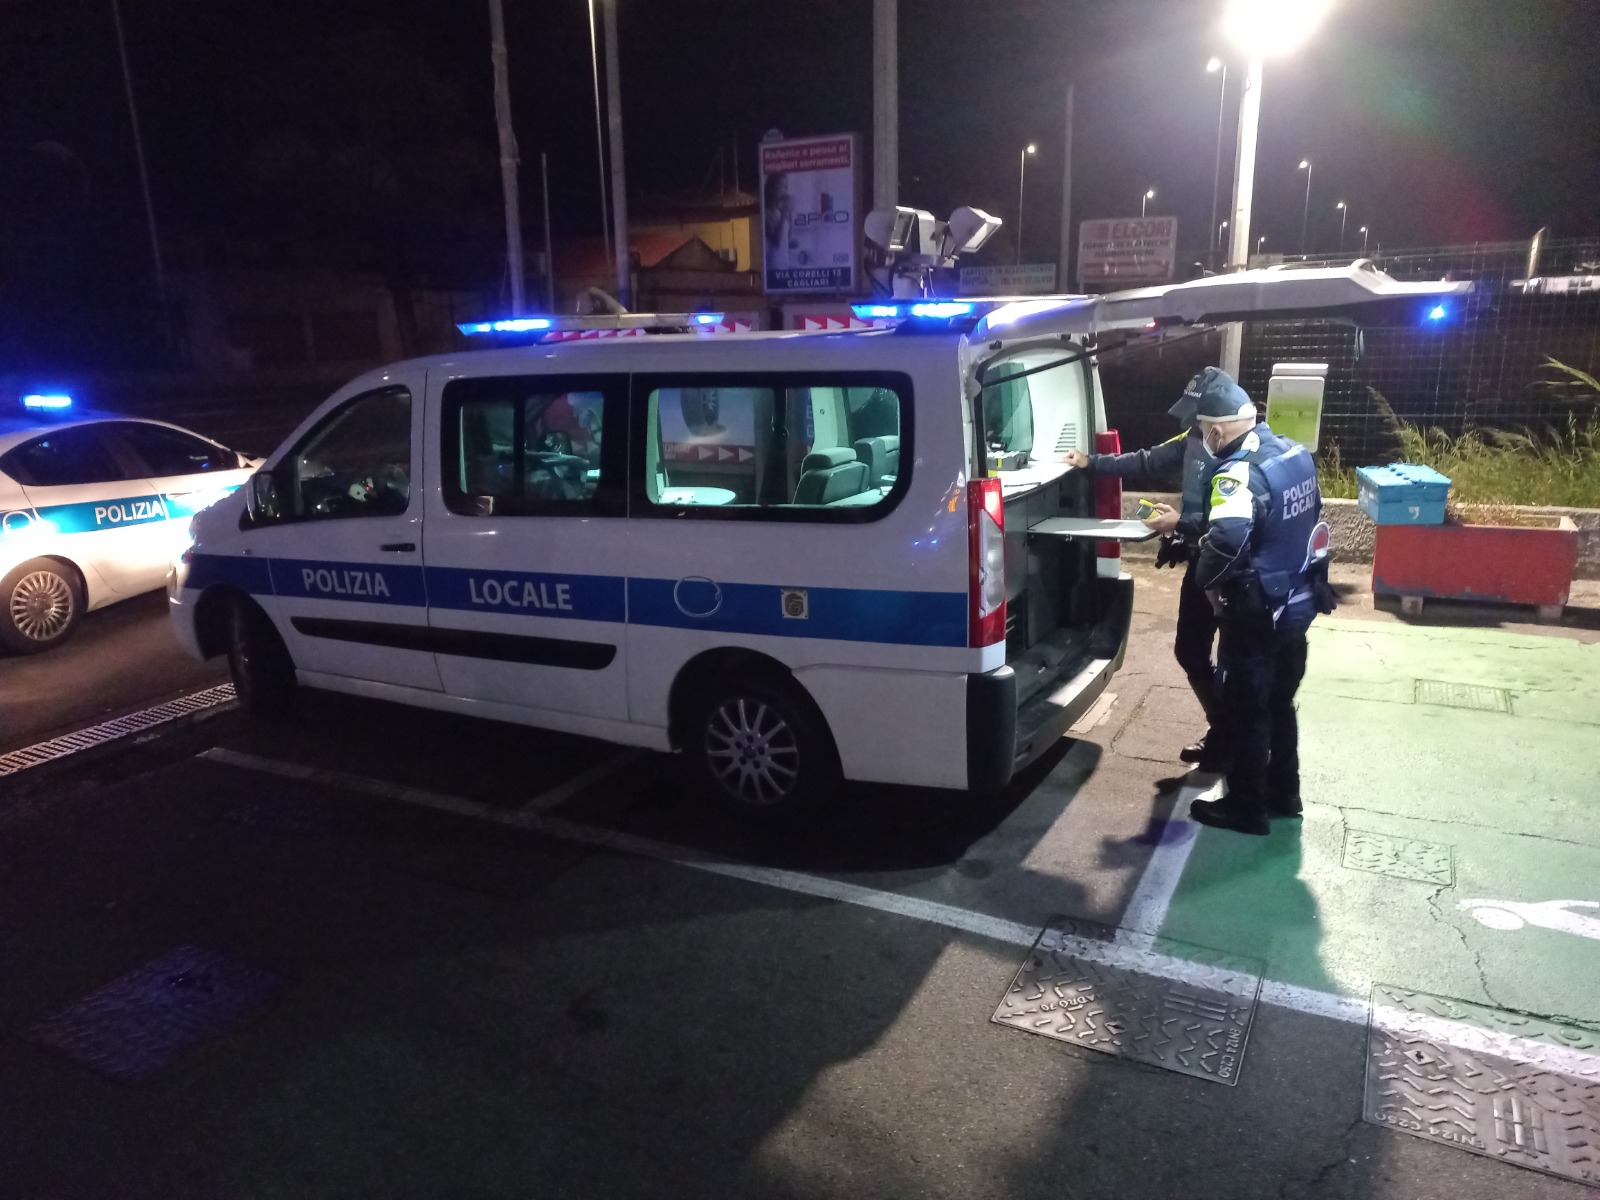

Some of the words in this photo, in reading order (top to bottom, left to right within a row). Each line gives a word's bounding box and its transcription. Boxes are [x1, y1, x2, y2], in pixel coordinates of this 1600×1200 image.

[775, 271, 790, 279] VIA
[793, 270, 829, 279] CORELLI
[787, 279, 829, 288] CAGLIARI
[1283, 475, 1317, 505] POLIZIA
[95, 500, 164, 525] POLIZIA
[302, 568, 390, 597] POLIZIA
[469, 578, 573, 610] LOCALE
[1218, 1054, 1236, 1078] C250
[1374, 1111, 1422, 1132] C250
